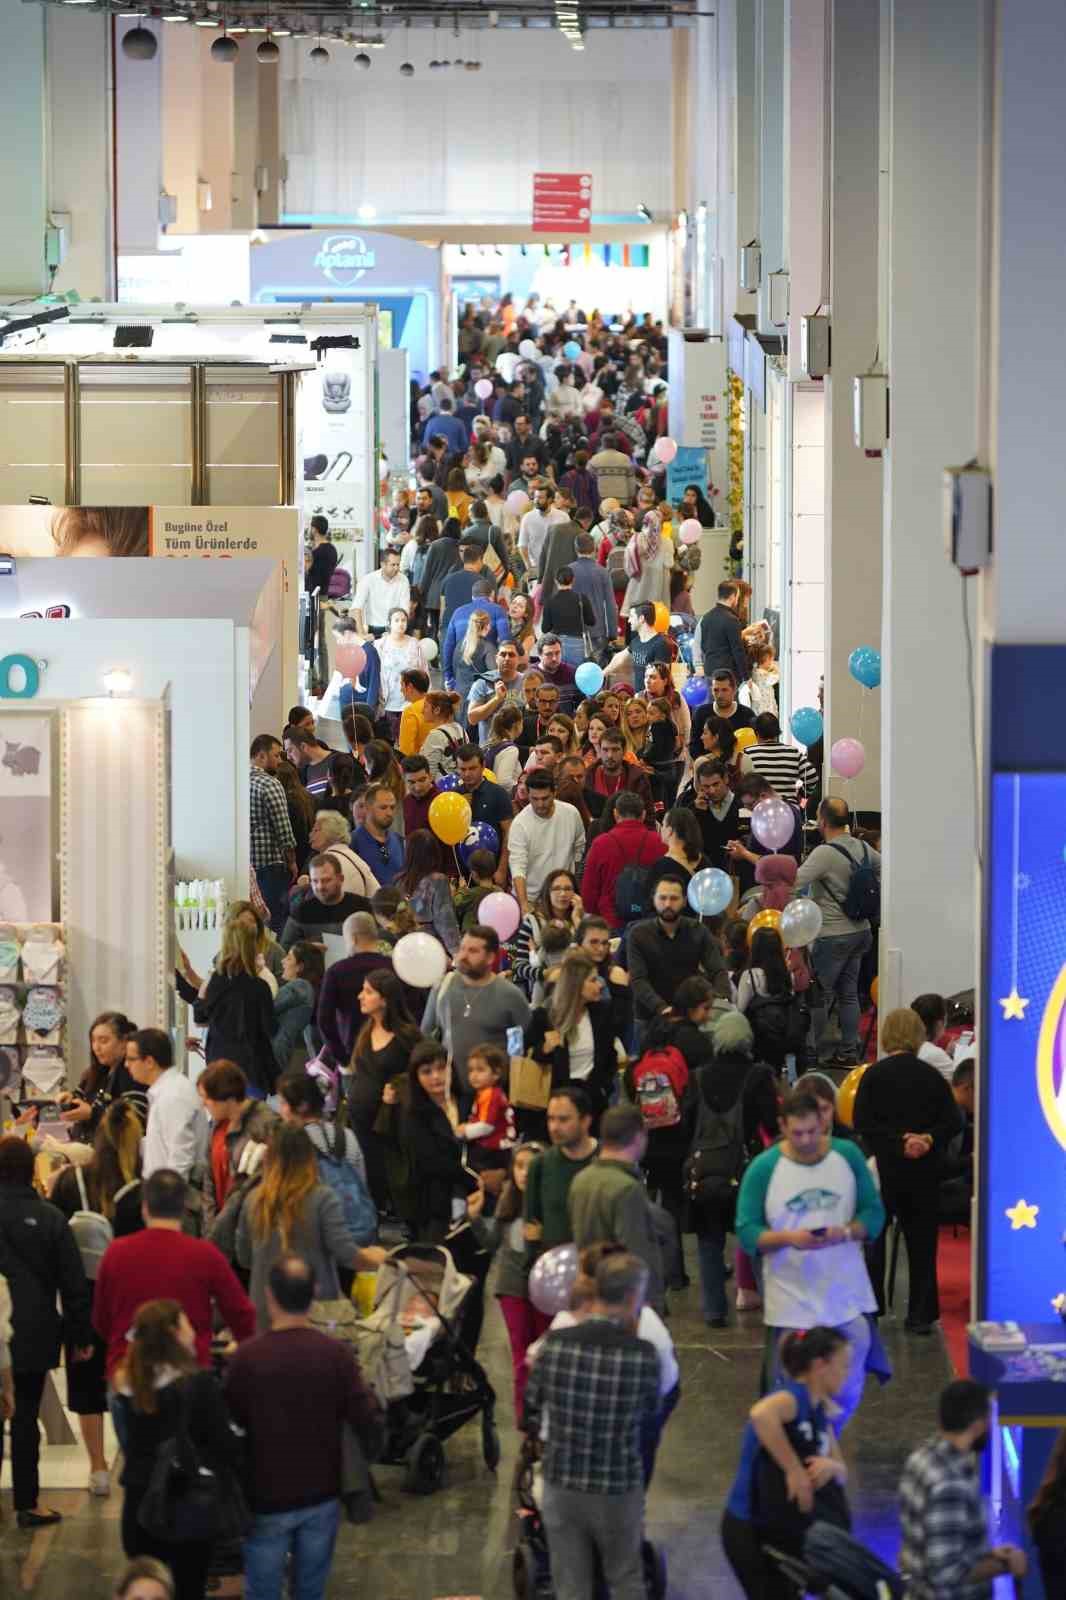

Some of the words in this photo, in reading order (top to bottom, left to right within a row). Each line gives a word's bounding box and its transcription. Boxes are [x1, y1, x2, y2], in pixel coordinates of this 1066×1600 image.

[165, 522, 203, 534] Bugüne
[206, 521, 228, 532] Özel
[166, 538, 191, 549] Tüm
[195, 536, 258, 549] Ürünlerde
